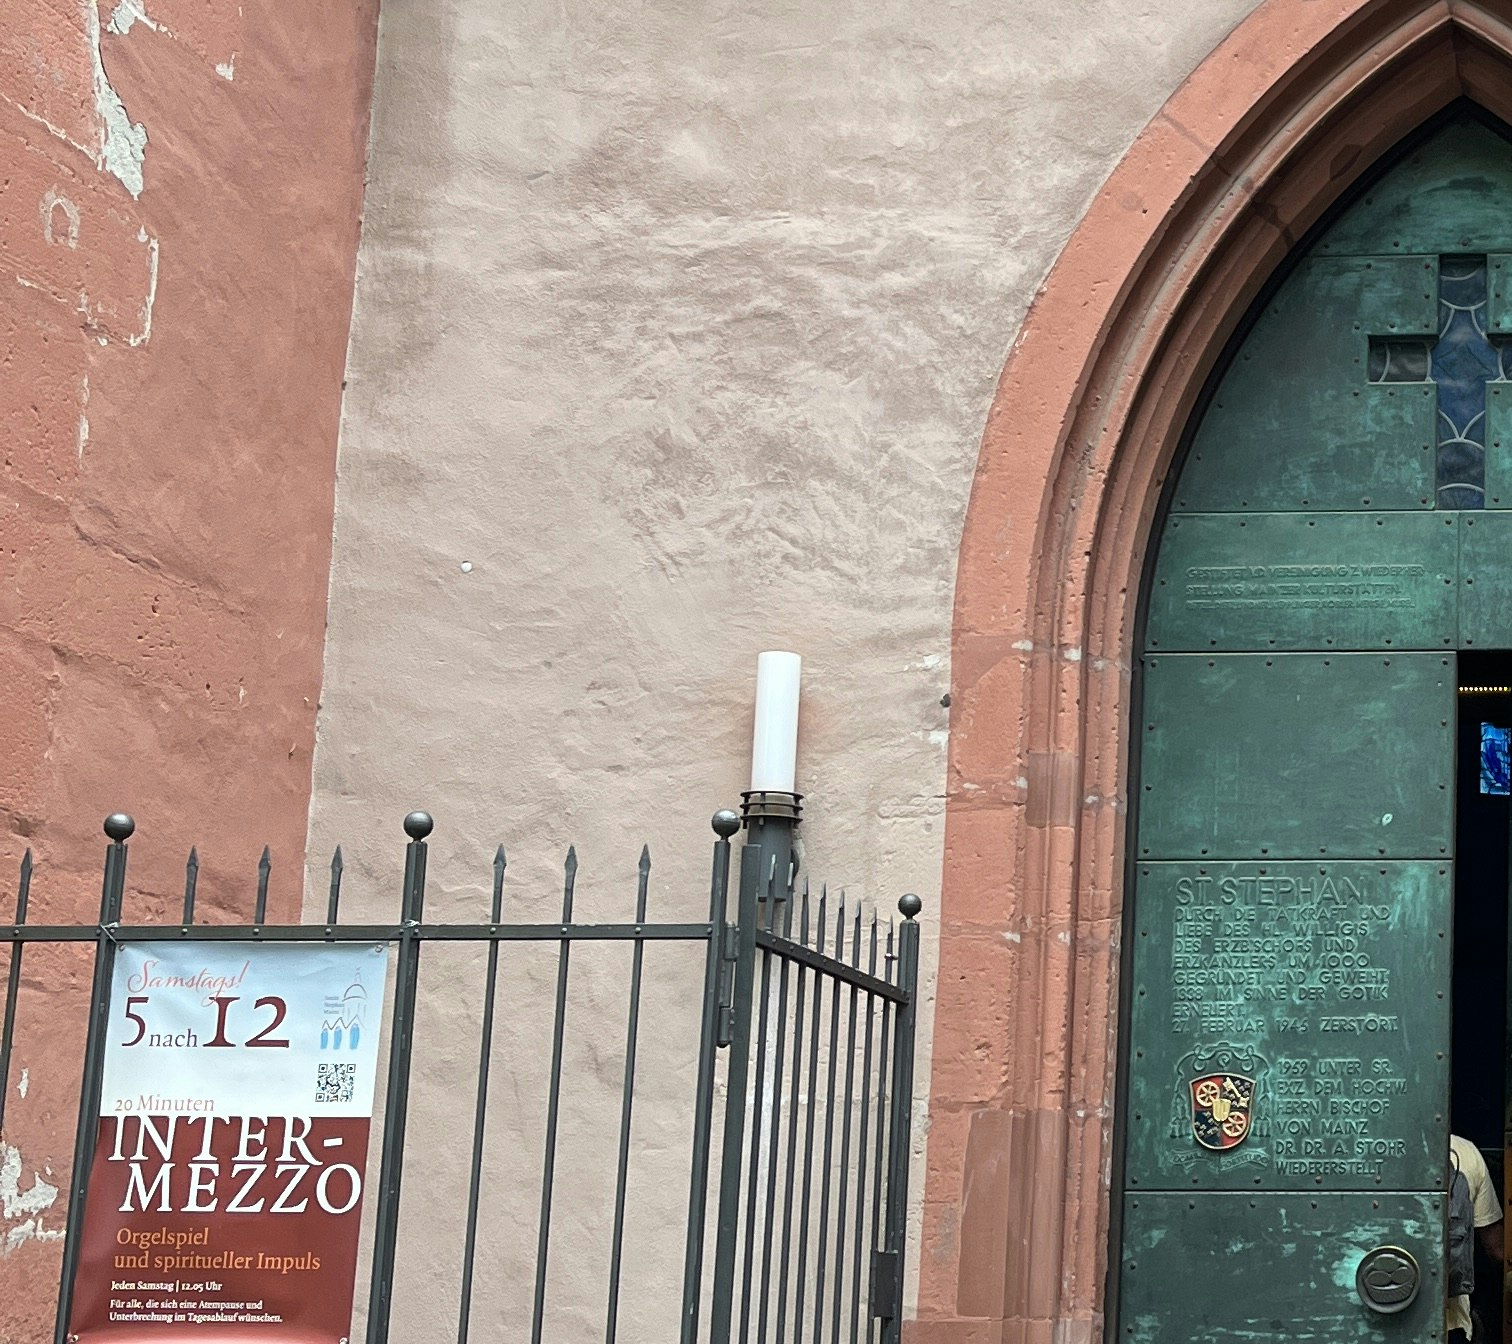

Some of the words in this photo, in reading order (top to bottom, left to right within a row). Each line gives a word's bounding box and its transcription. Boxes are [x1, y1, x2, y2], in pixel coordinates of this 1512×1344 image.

[1175, 877, 1214, 905] ST.
[1220, 877, 1364, 905] STEPHAN
[1175, 906, 1222, 922] DURCH
[1234, 906, 1256, 922] DIE
[1267, 905, 1348, 921] TATKRAFT
[1359, 905, 1392, 921] UND
[1174, 922, 1213, 937] LIEBE
[1223, 922, 1251, 937] DES
[1292, 920, 1370, 937] WILLIGIS
[1174, 938, 1202, 953] DES
[1212, 937, 1313, 953] ERZBISCHOFS
[1322, 937, 1358, 952] UND
[1173, 954, 1278, 970] ERZKANZLERS
[1288, 953, 1313, 968] UM
[1319, 952, 1371, 968] 1000
[127, 960, 251, 1007] Samstags!
[1276, 969, 1306, 985] UND
[1216, 985, 1234, 1001] IM
[1243, 985, 1288, 1001] SINNE
[1298, 985, 1326, 1000] DER
[1338, 984, 1389, 999] GOTIK
[121, 996, 149, 1048] 5
[149, 1028, 198, 1048] nach
[1200, 1017, 1265, 1033] FEBRUAR
[1316, 1058, 1362, 1075] UNTER
[1313, 1078, 1342, 1095] DEM
[114, 1098, 133, 1112] 20
[136, 1093, 215, 1112] Minuten
[1276, 1099, 1320, 1115] HERRN
[1329, 1098, 1390, 1115] BISCHOF
[1276, 1118, 1311, 1135] VON
[1321, 1118, 1369, 1135] MAINZ
[107, 1114, 343, 1166] INTER-
[1275, 1139, 1297, 1155] DR.
[1303, 1139, 1327, 1155] DR.
[1333, 1139, 1349, 1155] A.
[1275, 1158, 1384, 1175] WIEDERERSTELLT
[118, 1163, 362, 1214] MEZZO
[116, 1226, 209, 1250] Orgelspiel
[114, 1250, 150, 1269] und
[154, 1250, 253, 1273] spiritueller
[256, 1252, 321, 1274] Impuls
[110, 1280, 136, 1291] Jeden
[137, 1280, 174, 1293] Samstag
[181, 1282, 204, 1293] 12.05
[205, 1280, 223, 1291] Uhr
[110, 1299, 126, 1309] Für
[126, 1299, 144, 1310] alle,
[145, 1299, 160, 1309] die
[160, 1299, 178, 1309] sich
[179, 1299, 197, 1309] eine
[199, 1300, 245, 1311] Atempause
[245, 1300, 263, 1310] und
[109, 1311, 174, 1324] Unterbrechung
[174, 1312, 186, 1322] im
[187, 1312, 239, 1324] Tagesablauf
[238, 1313, 284, 1323] wünschen.
